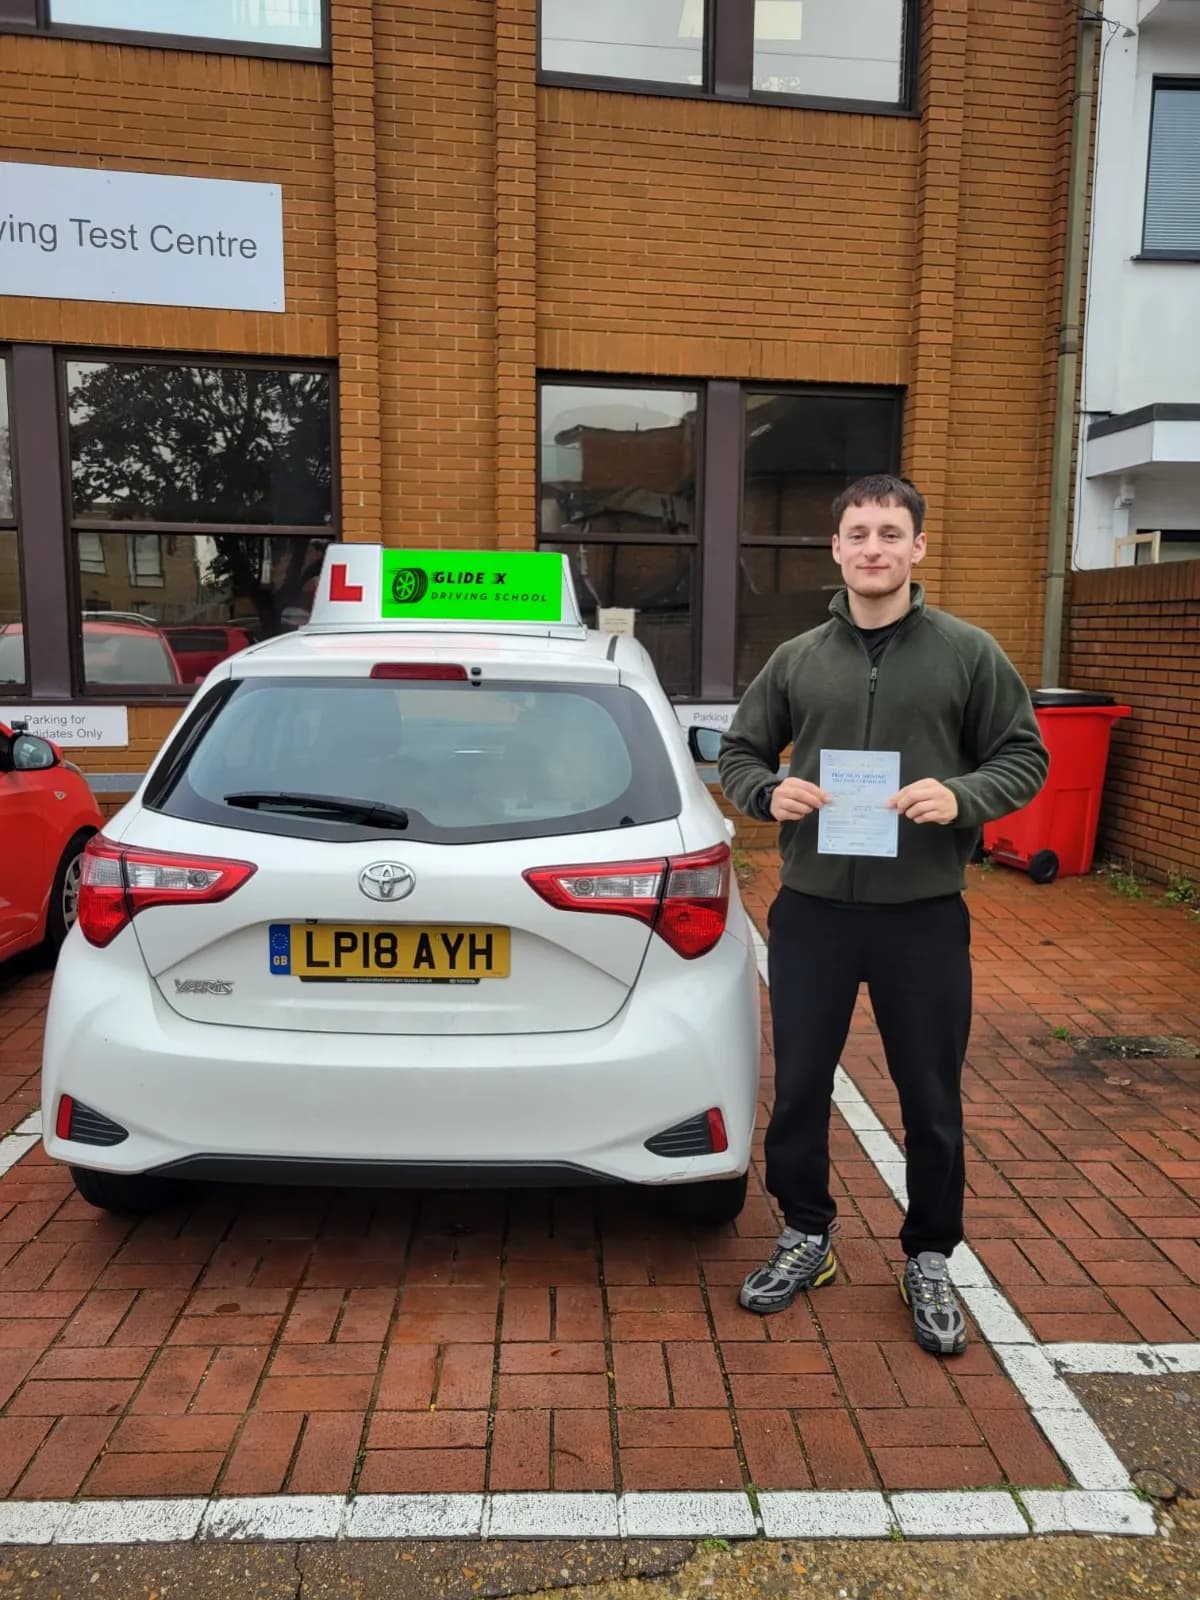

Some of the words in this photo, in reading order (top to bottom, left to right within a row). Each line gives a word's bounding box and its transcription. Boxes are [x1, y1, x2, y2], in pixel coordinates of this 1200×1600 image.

[69, 218, 138, 251] Test
[150, 225, 257, 259] Centre
[329, 564, 363, 602] L
[433, 571, 485, 585] GLIDE
[494, 572, 507, 585] X
[431, 591, 488, 601] DRIVING
[495, 592, 548, 603] SCHOOL
[24, 714, 68, 726] Parking
[71, 714, 87, 725] for
[693, 712, 728, 723] Parking
[76, 728, 103, 740] Only
[305, 931, 398, 969] LP18
[412, 933, 493, 971] AYH
[273, 955, 288, 967] GB
